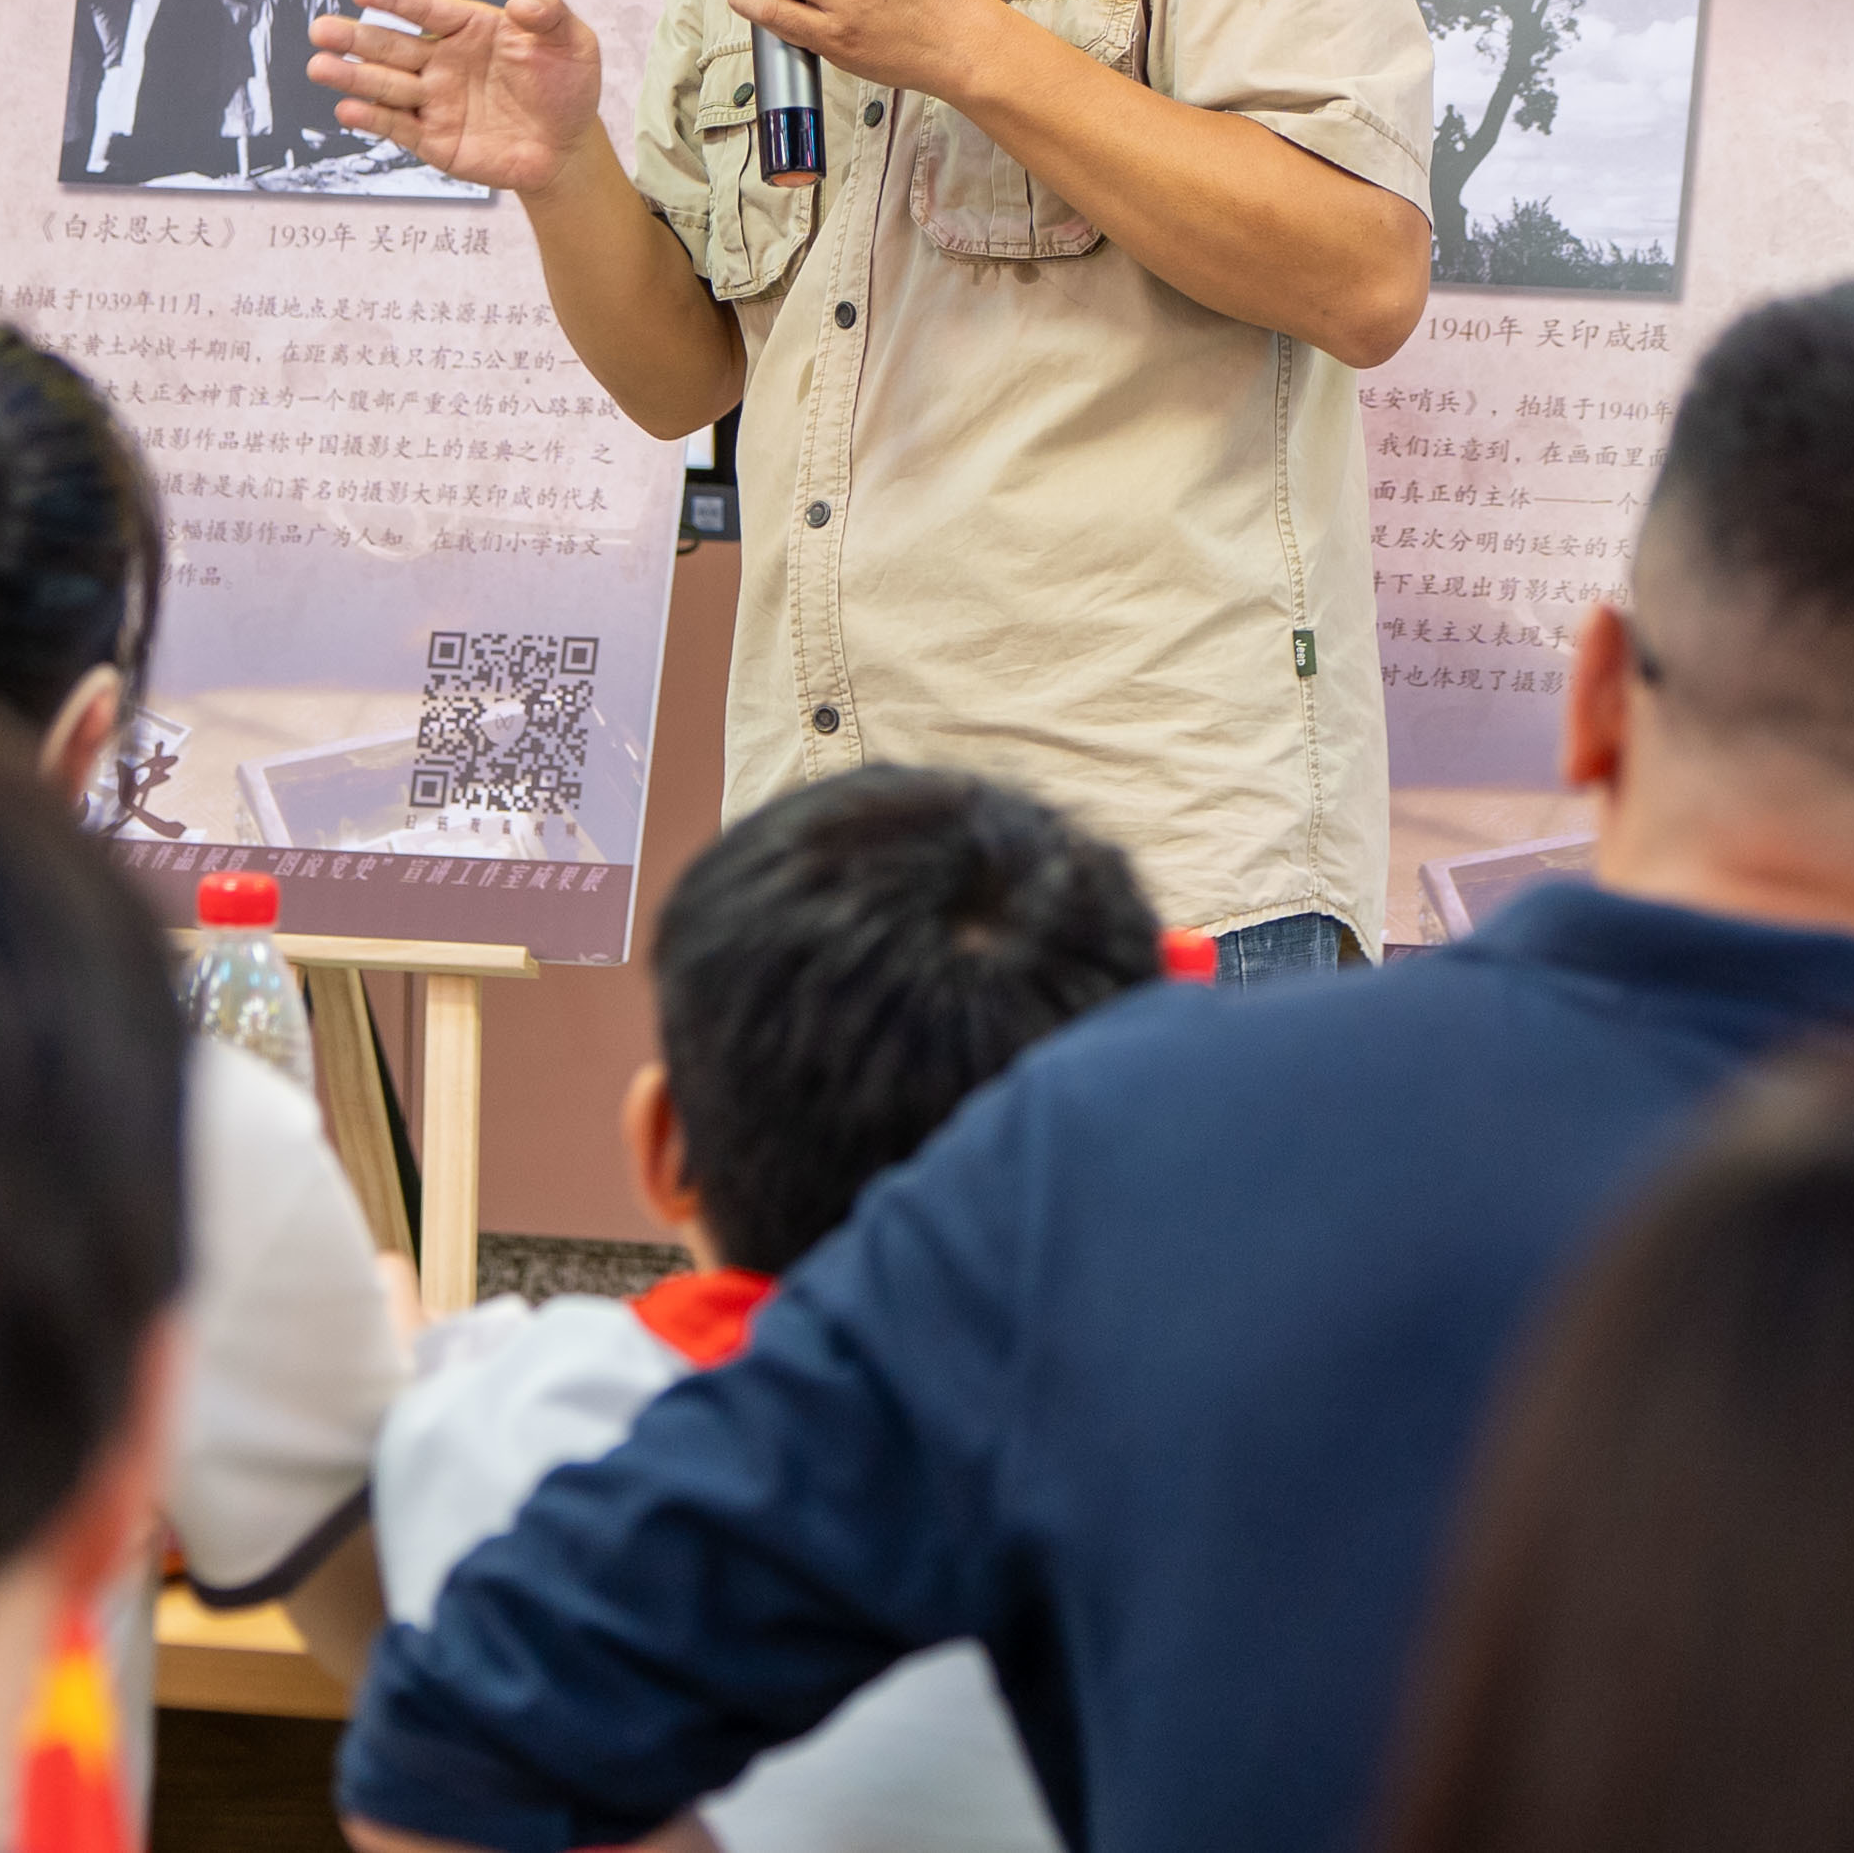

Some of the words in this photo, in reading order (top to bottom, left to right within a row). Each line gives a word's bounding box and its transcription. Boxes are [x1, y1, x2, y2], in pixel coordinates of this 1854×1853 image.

[42, 213, 235, 248] 《白求恩大夫》
[268, 222, 356, 254] 1939年
[369, 224, 492, 257] 吴印咸摄
[1427, 315, 1523, 347] 1940年
[1536, 319, 1671, 353] 吴印咸摄
[89, 377, 620, 421] 大夫正全神贯注为一个腹部严重受伤的八路军战
[132, 426, 614, 464] 摄影作品堪称中国摄影史上的經典之作。之
[153, 471, 608, 511] 摄者是我们著名的摄影大师吴印咸的代表
[1370, 524, 1634, 560] 是层次分明的延安的天
[1375, 617, 1577, 650] 唯美主义表现手
[1381, 663, 1571, 696] 时也体现了摄影
